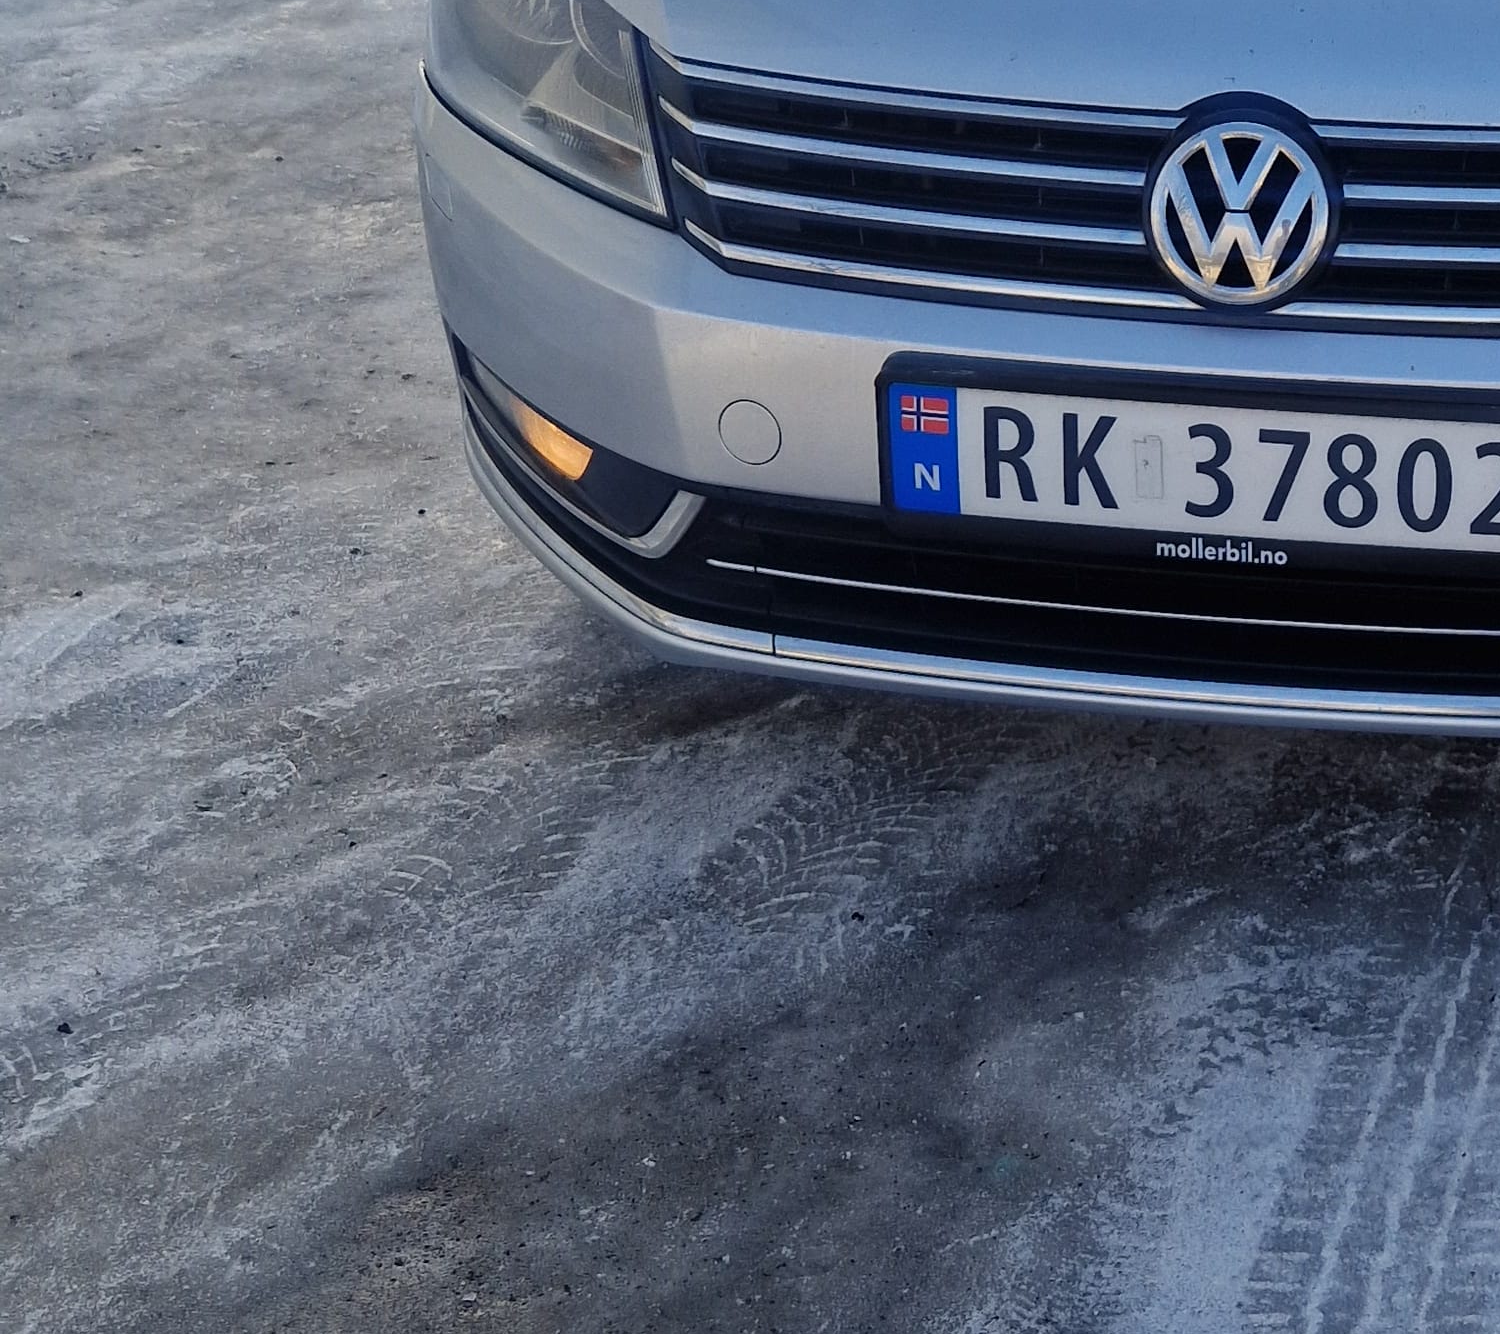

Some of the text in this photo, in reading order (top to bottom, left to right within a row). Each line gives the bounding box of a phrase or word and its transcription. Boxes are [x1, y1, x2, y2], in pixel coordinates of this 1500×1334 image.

[1151, 122, 1328, 304] VW
[914, 463, 940, 491] N
[983, 406, 1119, 509] RK
[1156, 537, 1288, 565] mollerbil.no
